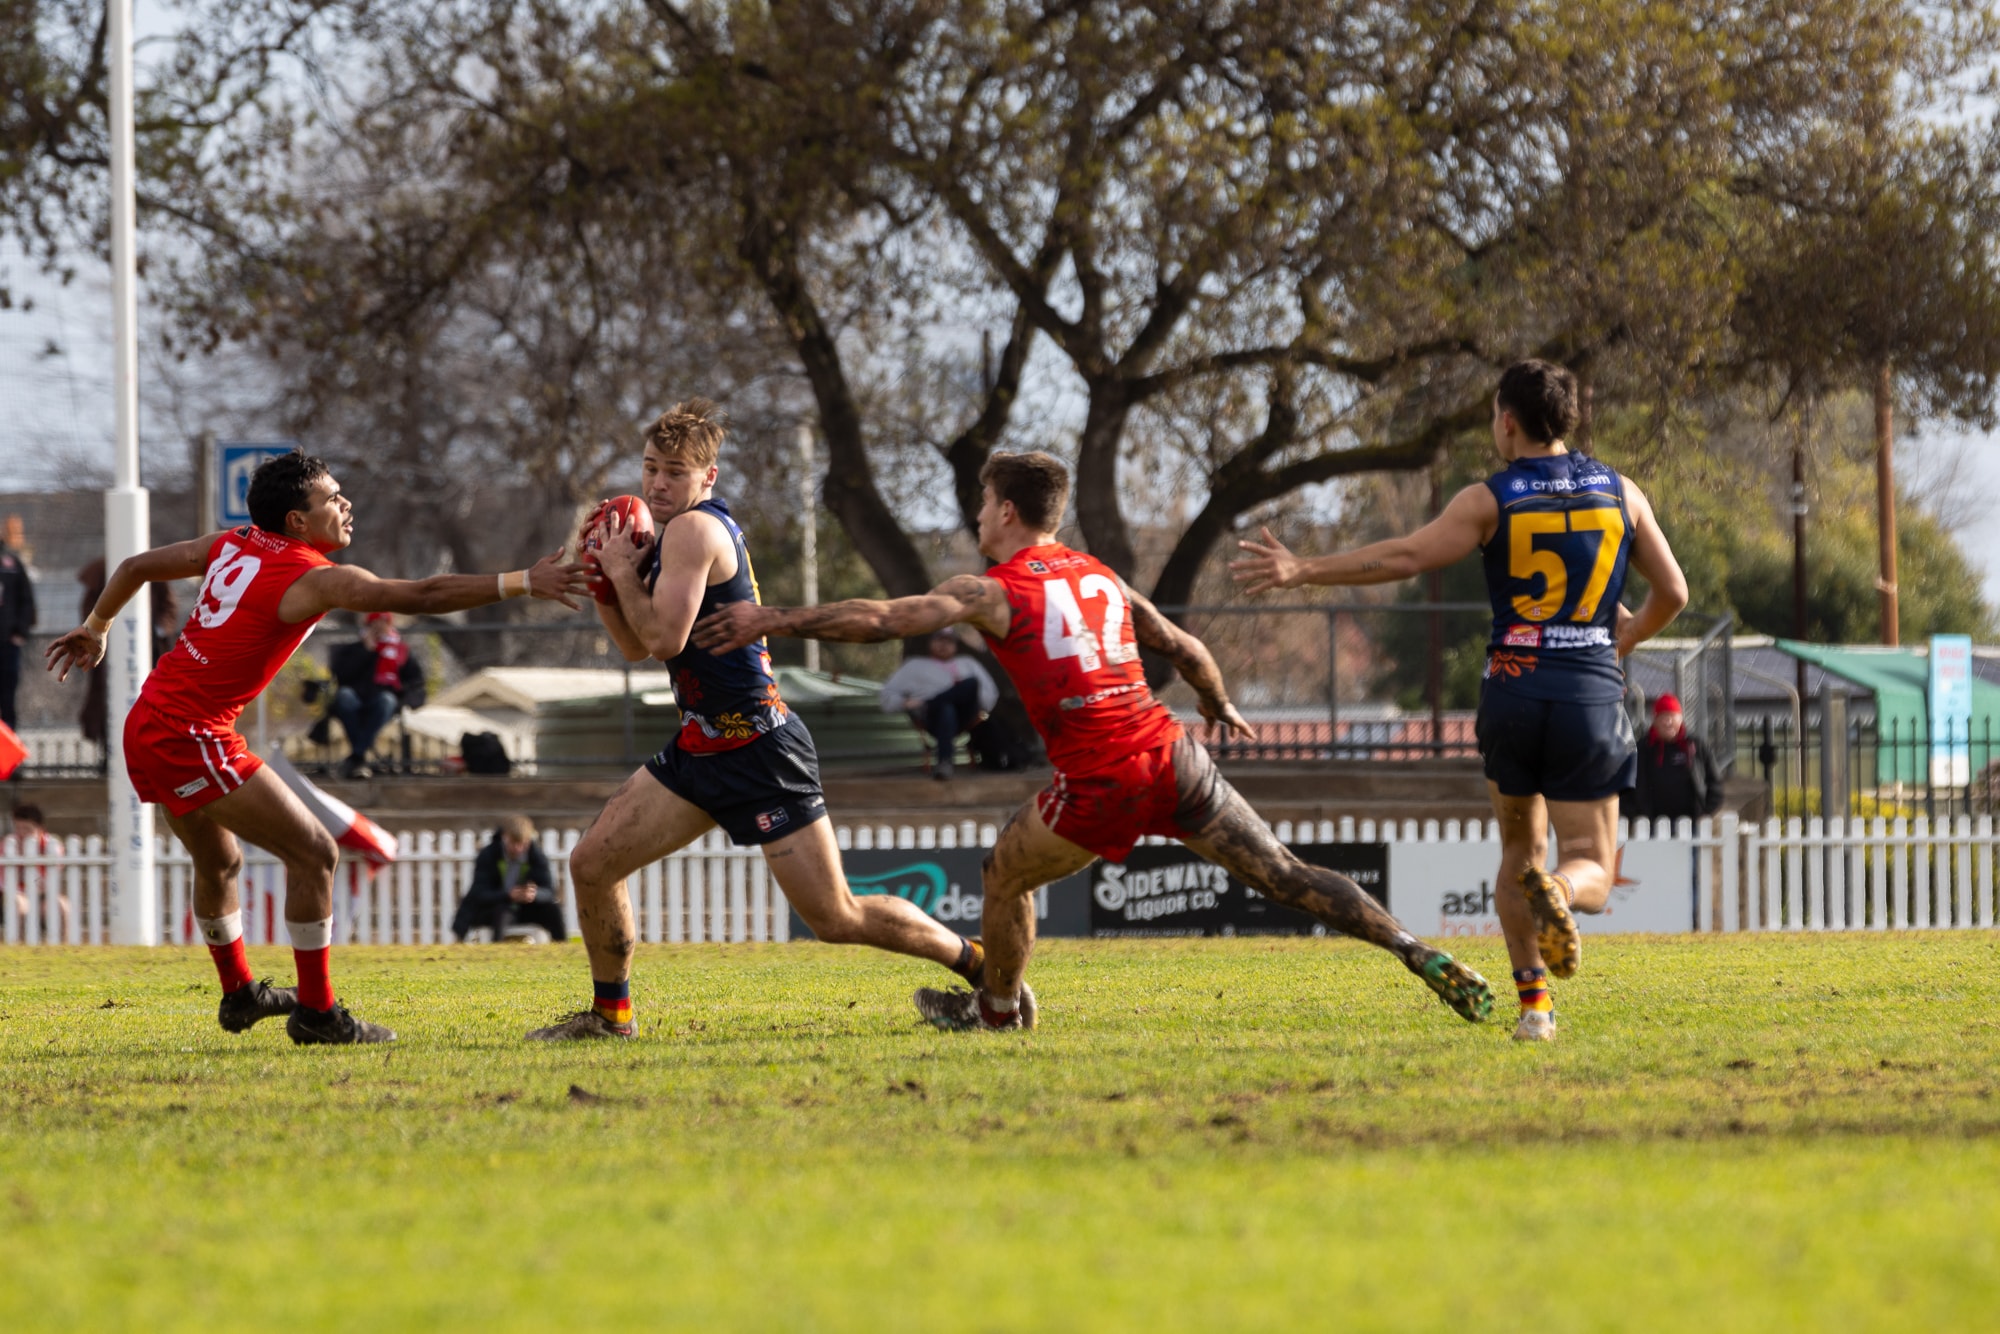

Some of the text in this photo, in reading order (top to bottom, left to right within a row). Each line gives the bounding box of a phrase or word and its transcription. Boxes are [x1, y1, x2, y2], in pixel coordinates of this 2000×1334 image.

[1531, 474, 1611, 493] crypto.com
[1510, 508, 1625, 622] 57
[1043, 574, 1143, 673] 42
[1094, 863, 1230, 910] SIDEWAYS
[1124, 894, 1188, 921] LIQUOR
